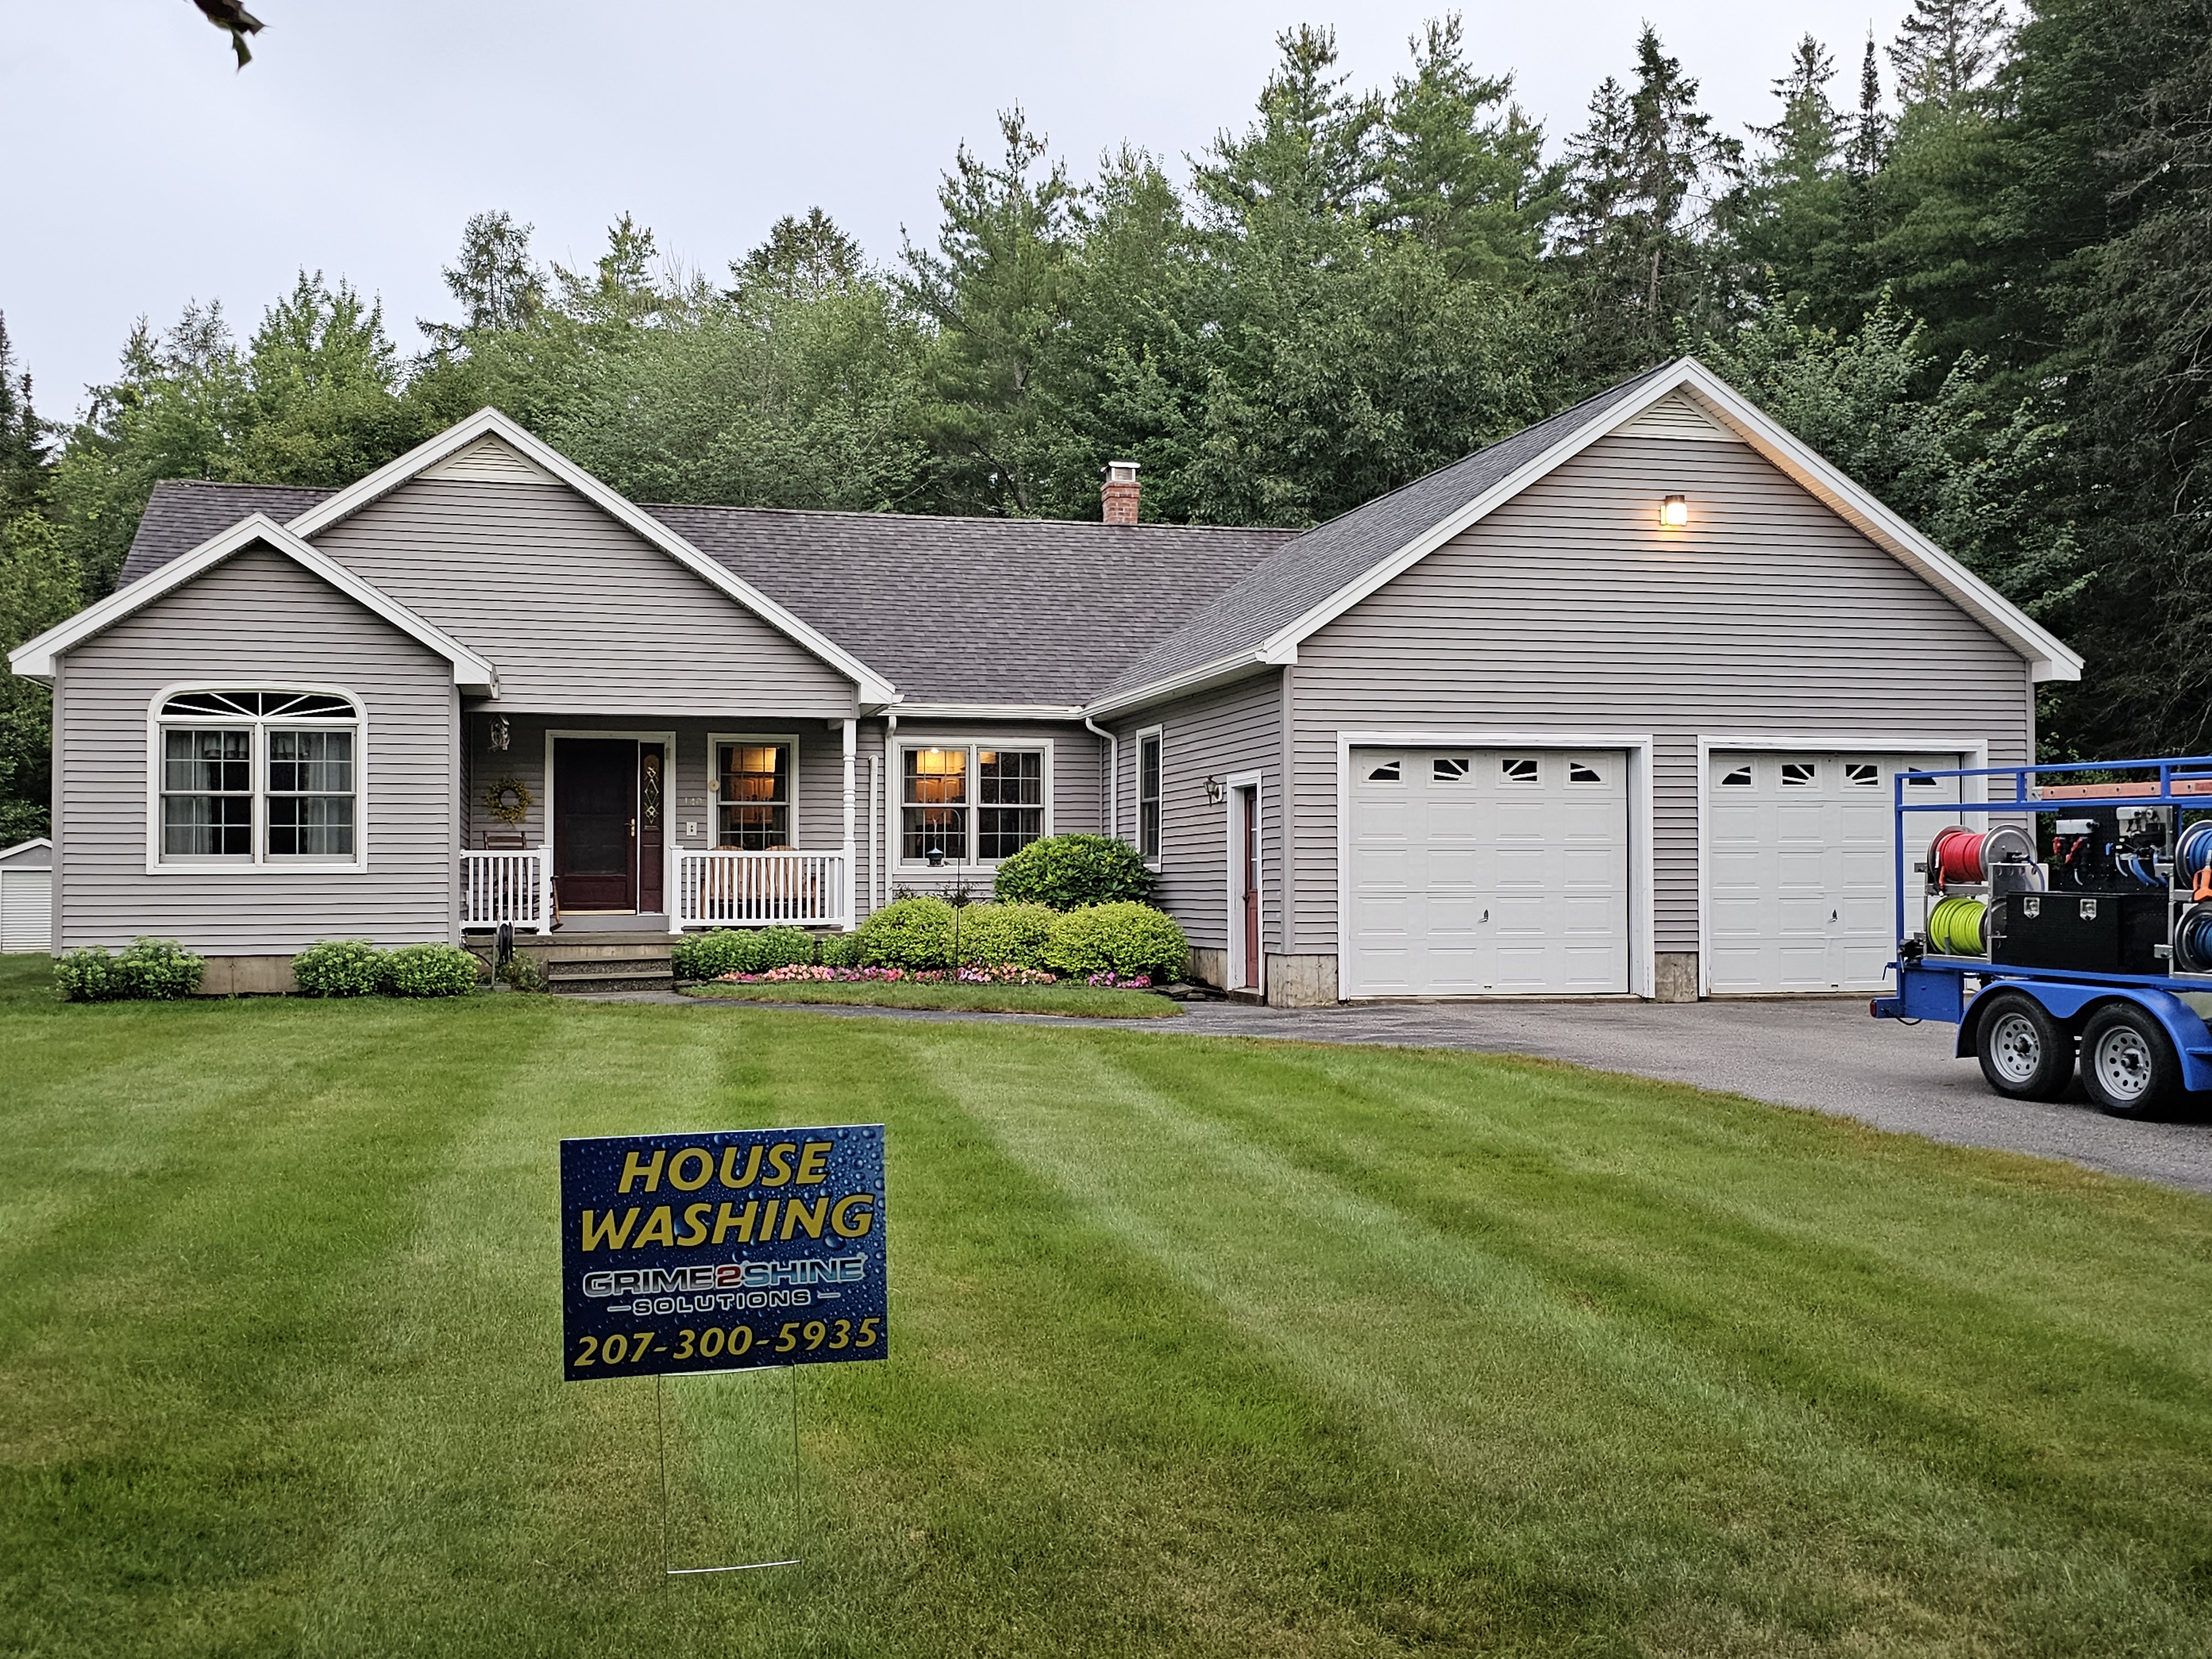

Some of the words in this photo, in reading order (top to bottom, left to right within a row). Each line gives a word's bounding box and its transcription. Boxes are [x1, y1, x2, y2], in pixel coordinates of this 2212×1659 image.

[618, 1142, 832, 1193] HOUSE
[582, 1194, 875, 1251] WASHING
[583, 1256, 864, 1297] GRIME2SHINE
[633, 1289, 811, 1316] SOLUTIONS
[573, 1318, 880, 1366] 207-300-5935
